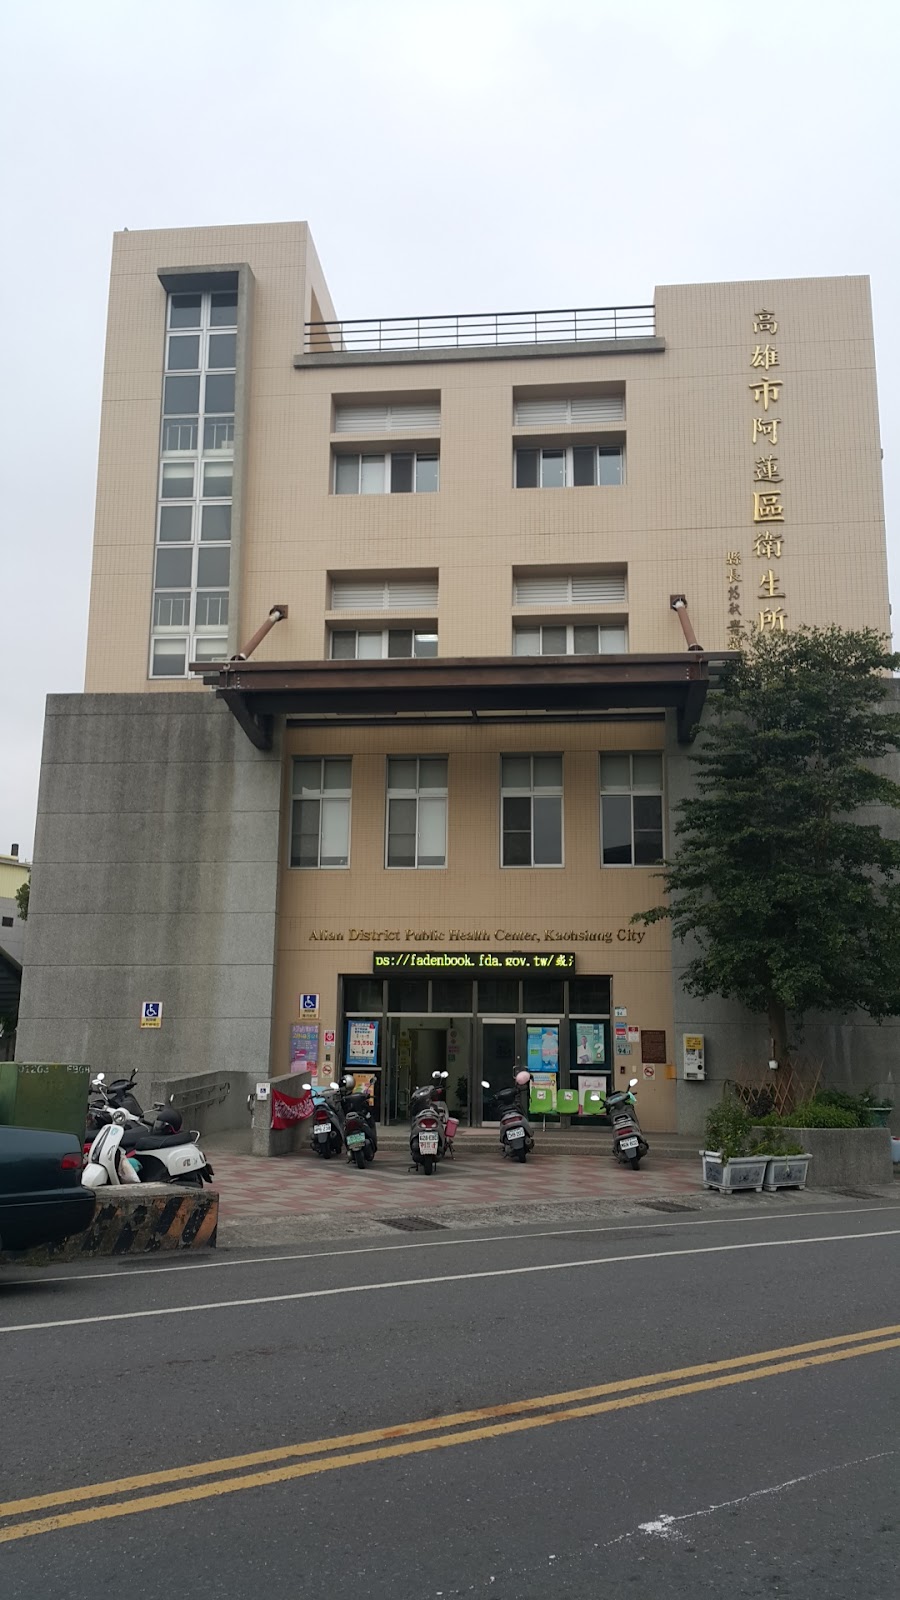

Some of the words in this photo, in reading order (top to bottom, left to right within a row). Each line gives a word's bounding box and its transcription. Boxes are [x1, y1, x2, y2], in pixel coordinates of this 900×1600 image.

[749, 308, 788, 632] 高雄市阿蓮區衛生所
[309, 929, 344, 941] Alian
[348, 929, 401, 941] District
[405, 929, 446, 941] Public
[449, 929, 491, 941] Health
[494, 929, 541, 943] Center,
[544, 929, 613, 943] Kaohsiung
[616, 929, 646, 943] City
